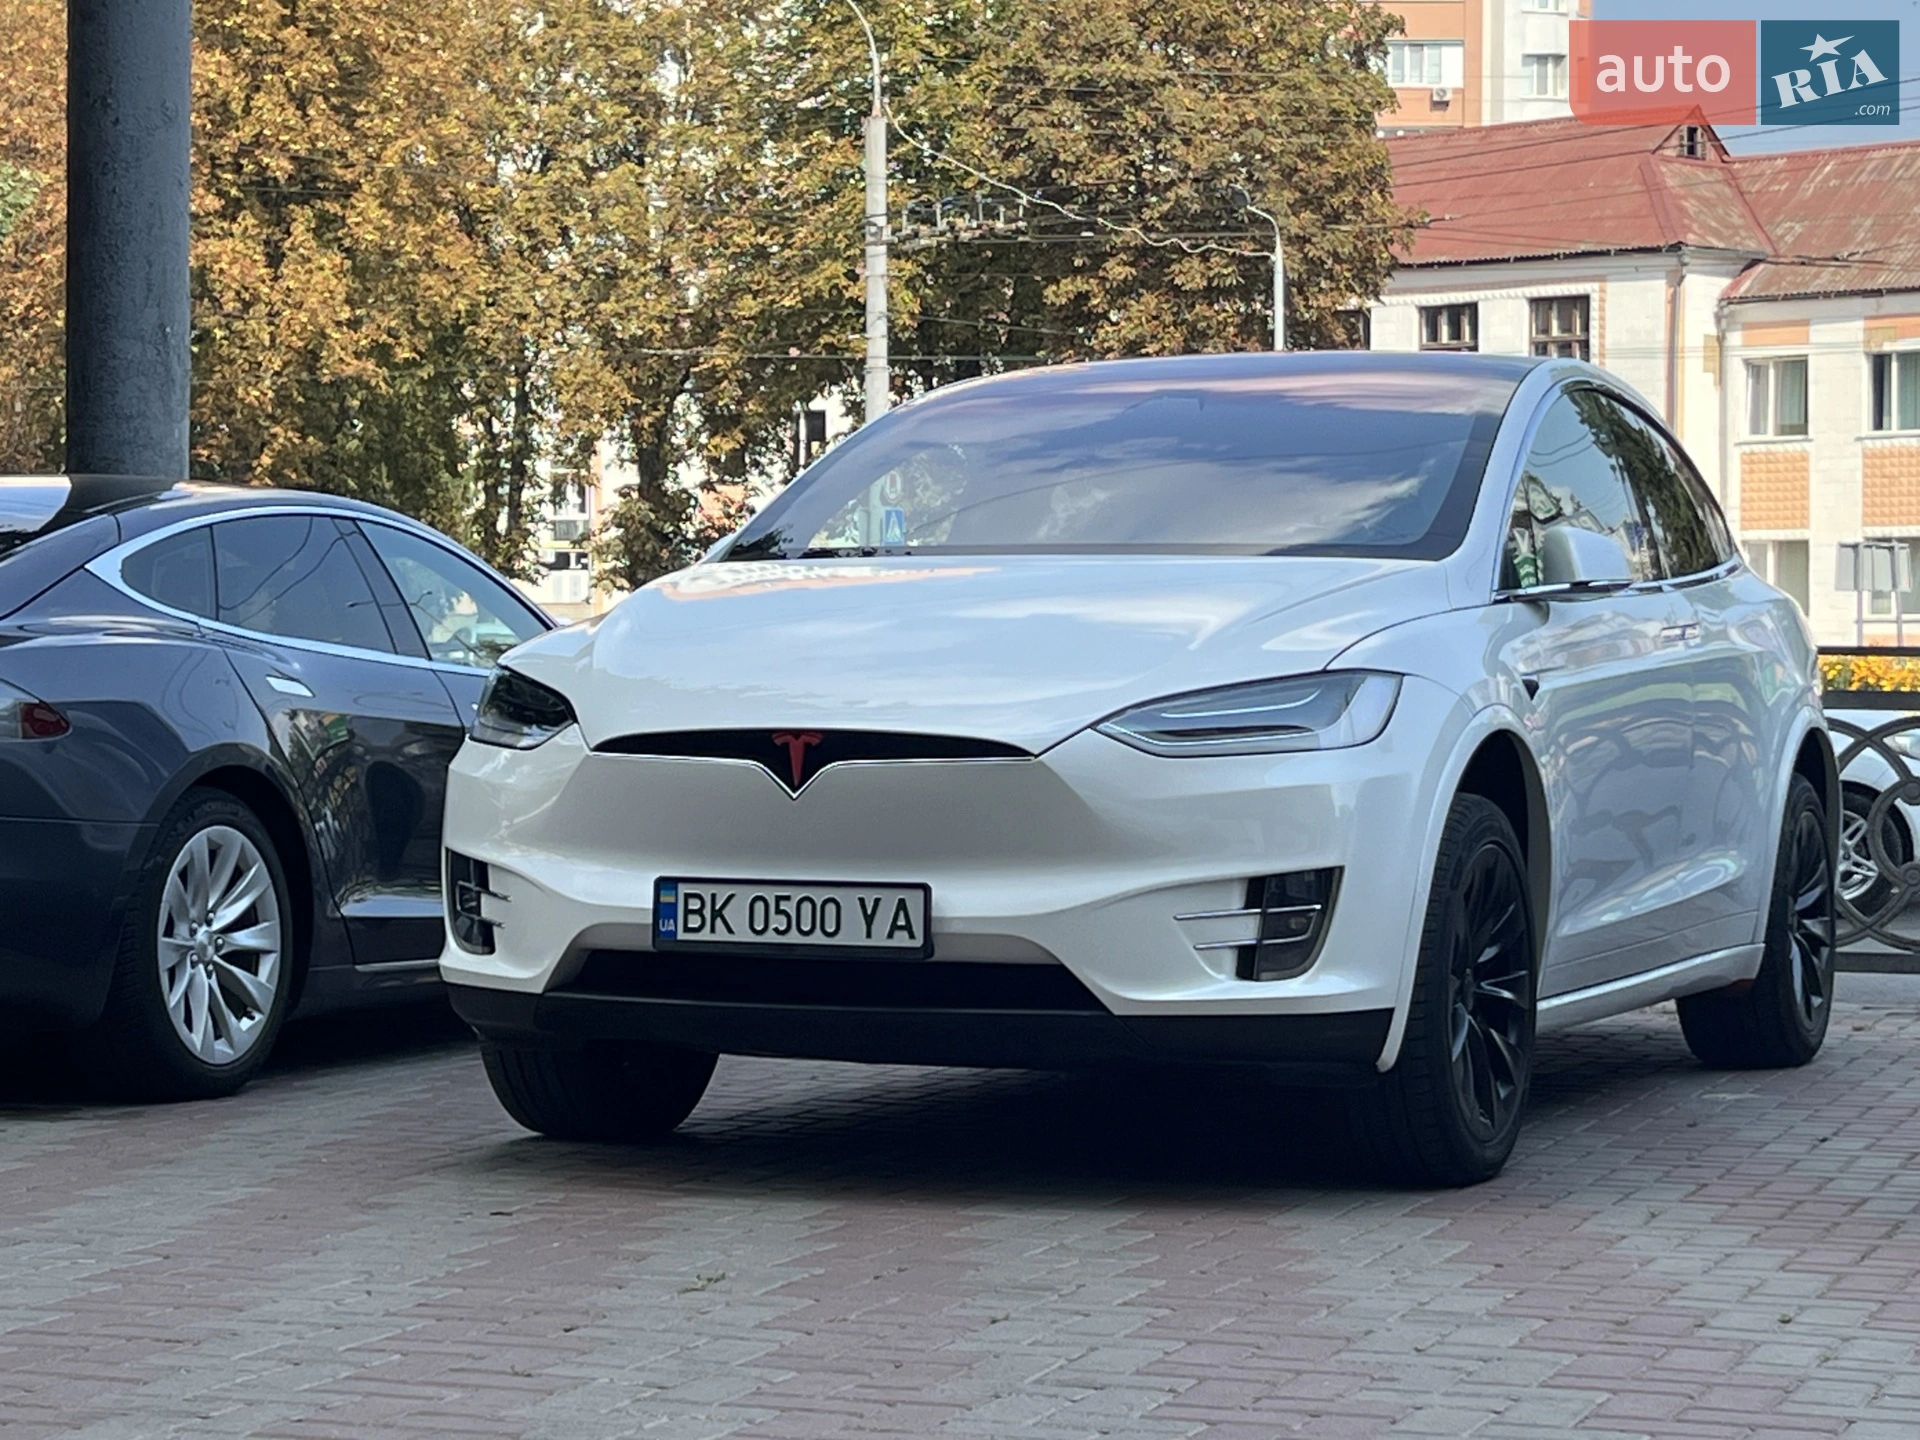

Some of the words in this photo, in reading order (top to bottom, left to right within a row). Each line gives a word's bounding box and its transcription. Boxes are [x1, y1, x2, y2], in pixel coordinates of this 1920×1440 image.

[659, 918, 676, 931] UA
[682, 891, 736, 935] BK
[748, 894, 842, 938] 0500
[857, 896, 917, 940] YA
